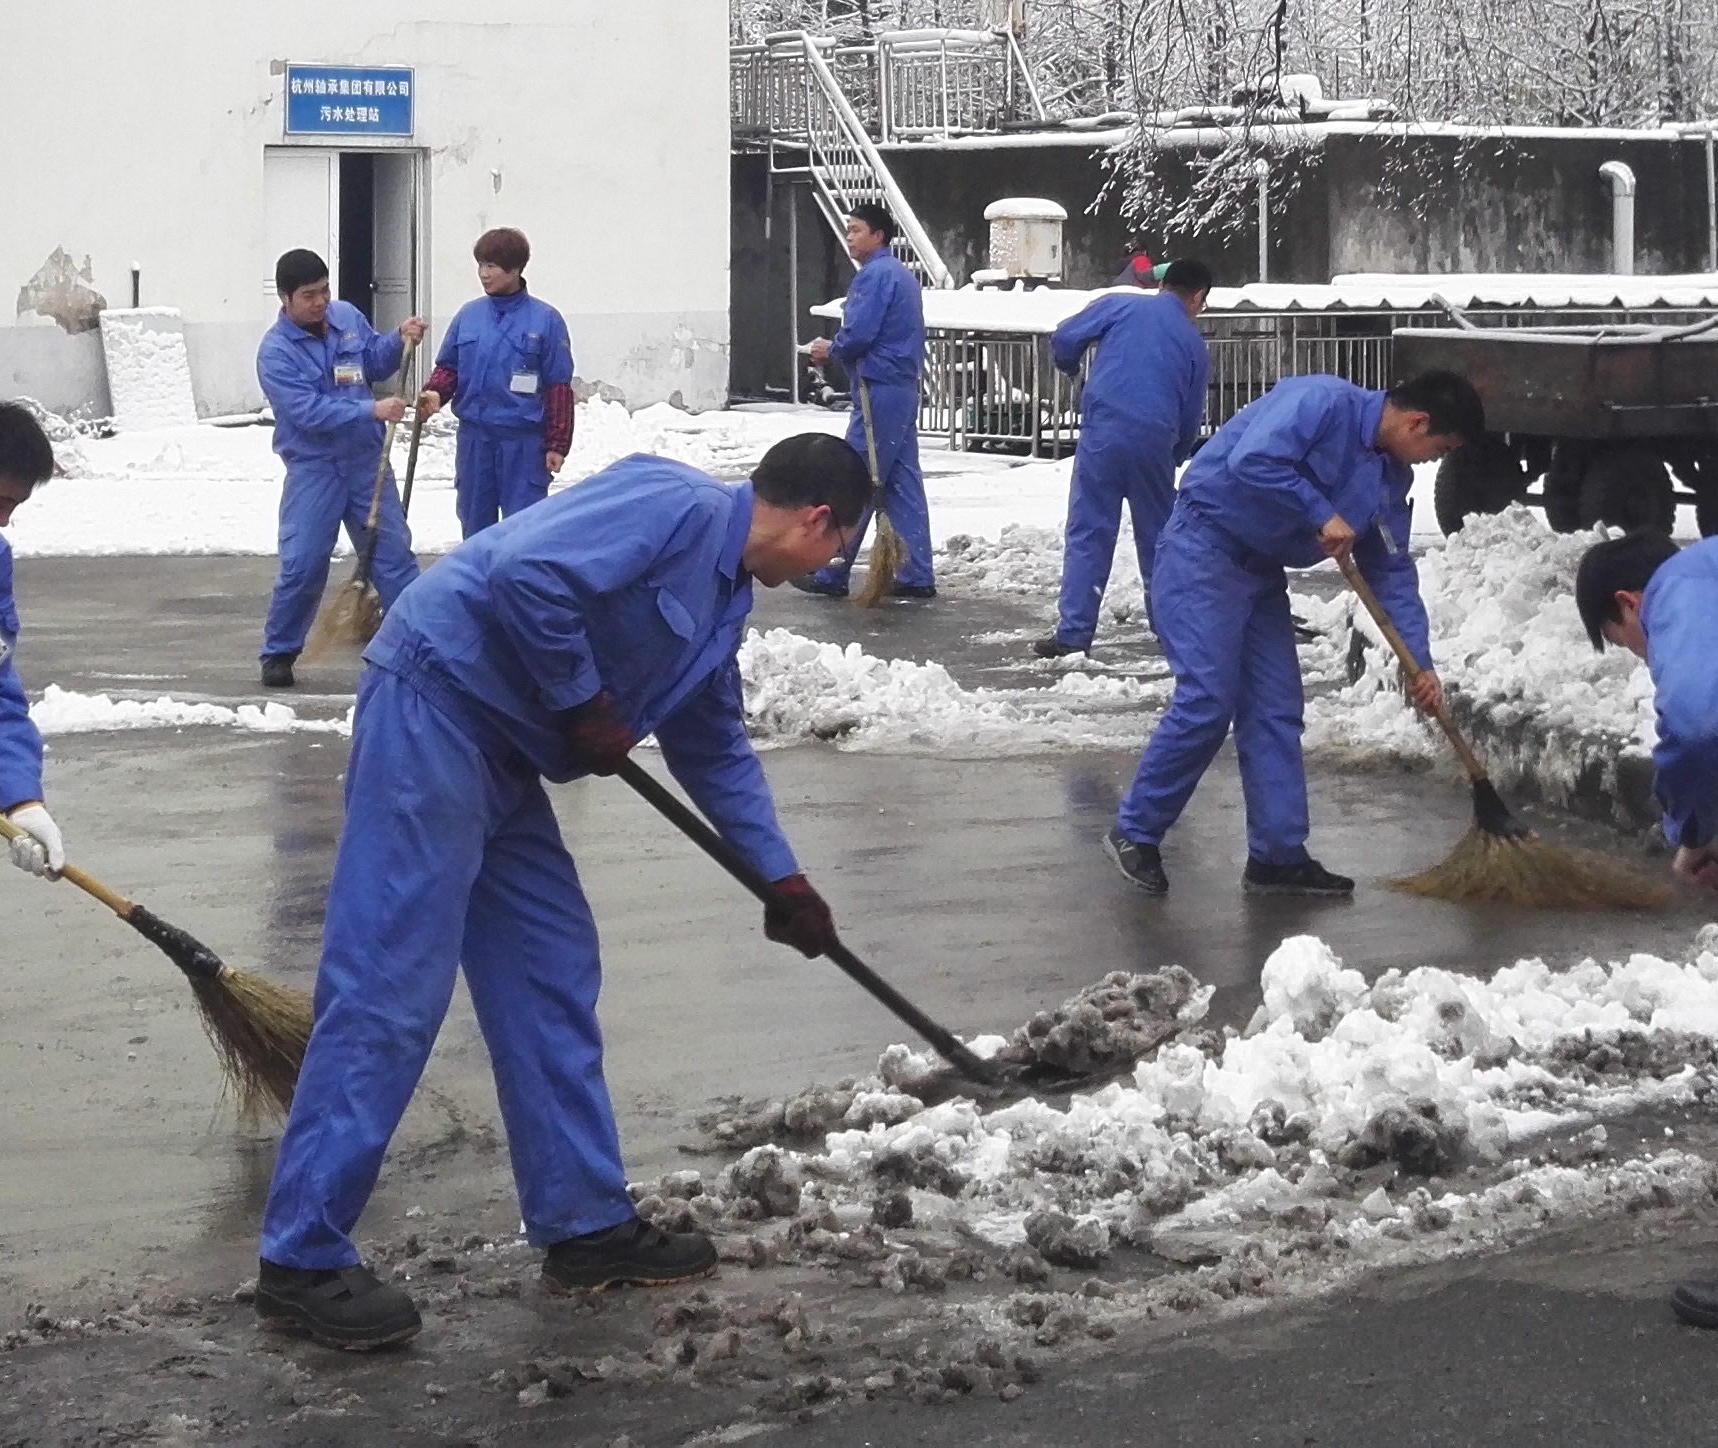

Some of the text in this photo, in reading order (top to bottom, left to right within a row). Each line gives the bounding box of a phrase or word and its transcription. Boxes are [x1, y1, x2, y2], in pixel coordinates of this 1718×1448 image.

[290, 78, 410, 97] 杭州轴承集团有限公司
[320, 106, 380, 123] 污水处理站
